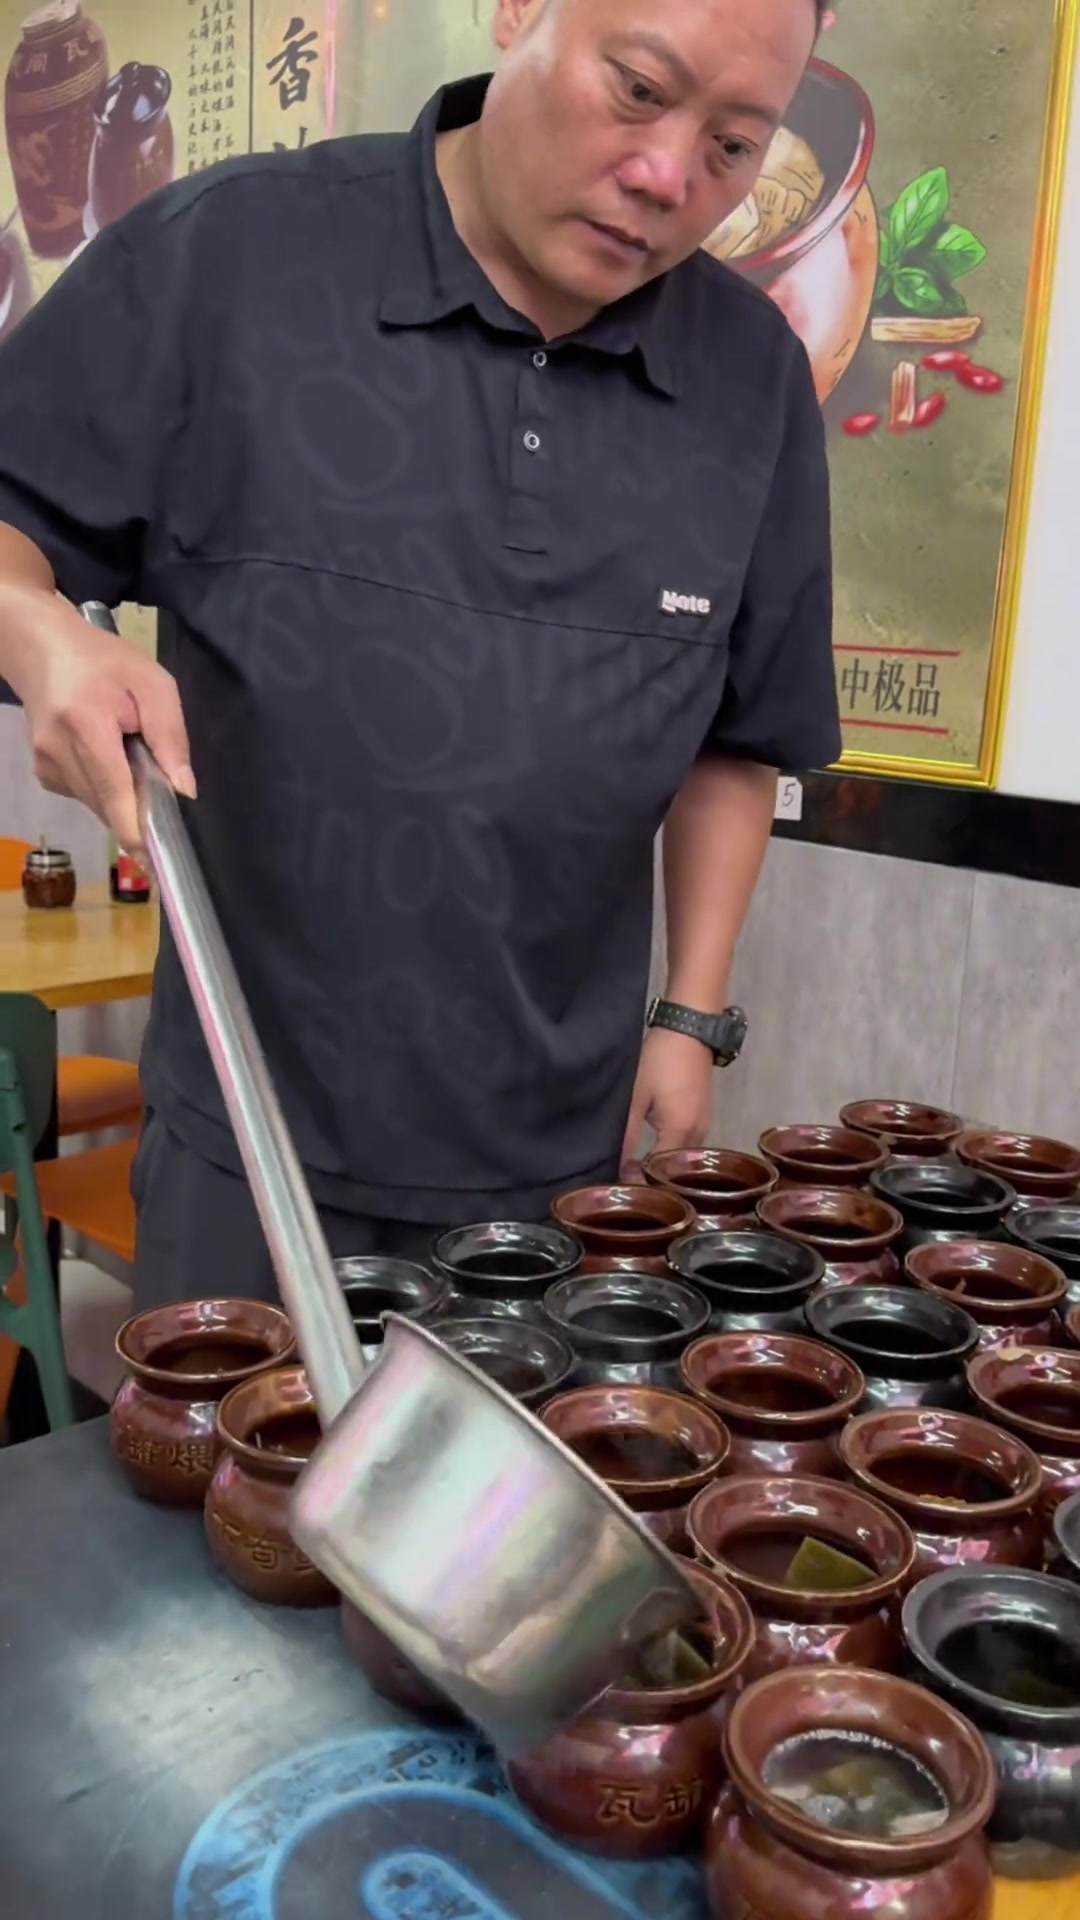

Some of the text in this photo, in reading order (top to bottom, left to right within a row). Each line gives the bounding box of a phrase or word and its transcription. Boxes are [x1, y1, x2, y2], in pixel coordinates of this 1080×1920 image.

[266, 17, 317, 151] 香
[841, 658, 940, 717] 中极品
[781, 782, 797, 807] 5
